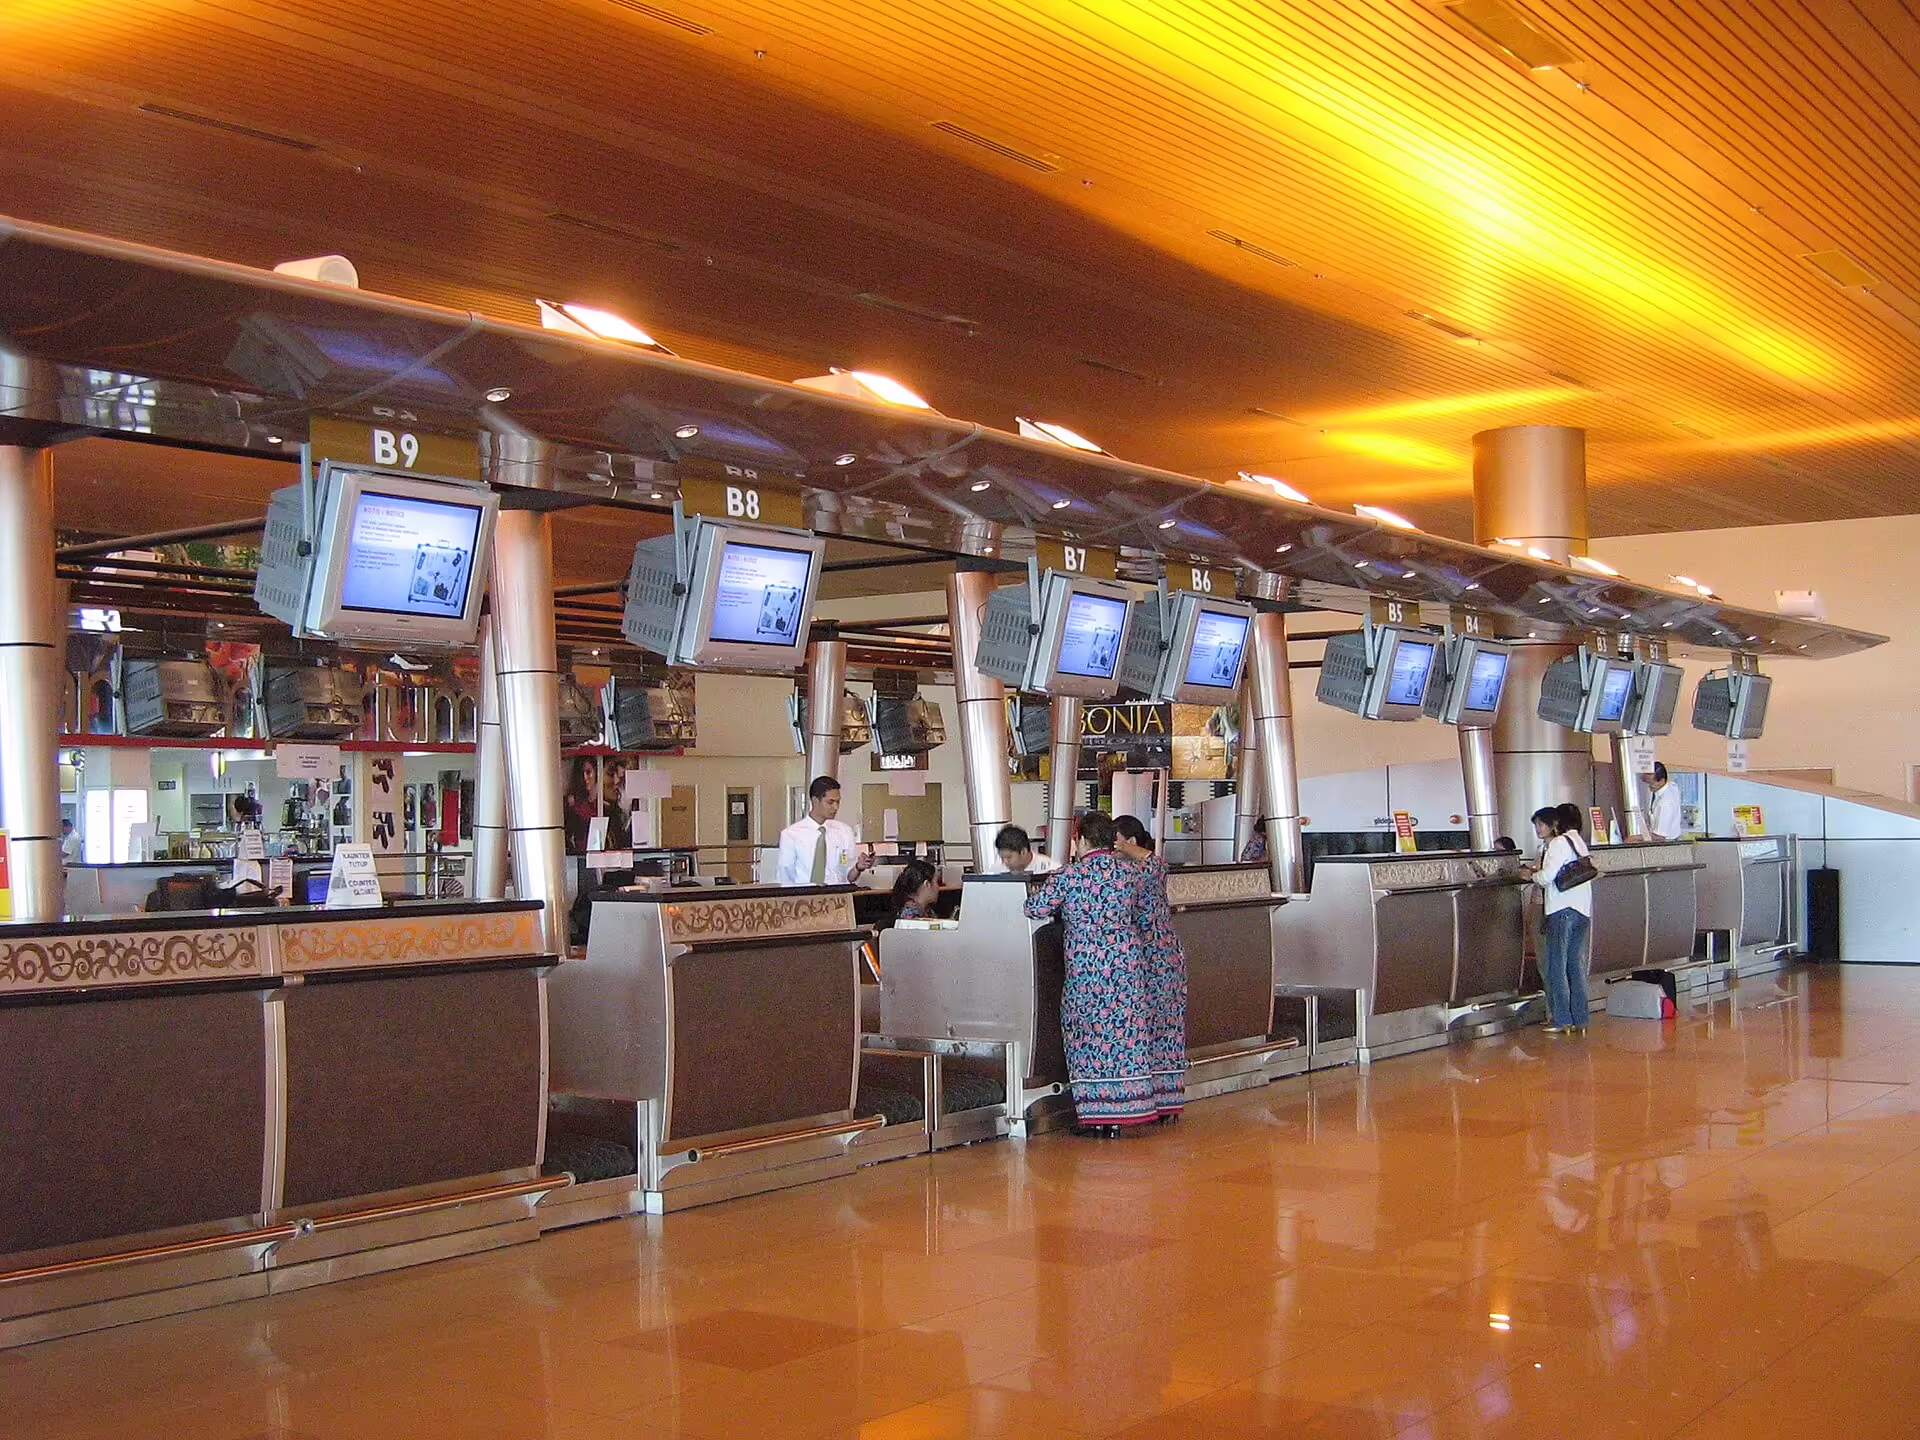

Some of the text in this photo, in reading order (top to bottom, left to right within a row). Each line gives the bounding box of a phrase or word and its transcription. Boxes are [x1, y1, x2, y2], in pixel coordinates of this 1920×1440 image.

[374, 429, 419, 468] B9
[726, 486, 760, 520] B8
[1064, 546, 1087, 572] B7
[1191, 568, 1212, 593] B6
[1388, 602, 1403, 623] B5
[1465, 615, 1480, 634] B4
[1596, 635, 1608, 653] B3
[347, 879, 377, 888] COUNTER
